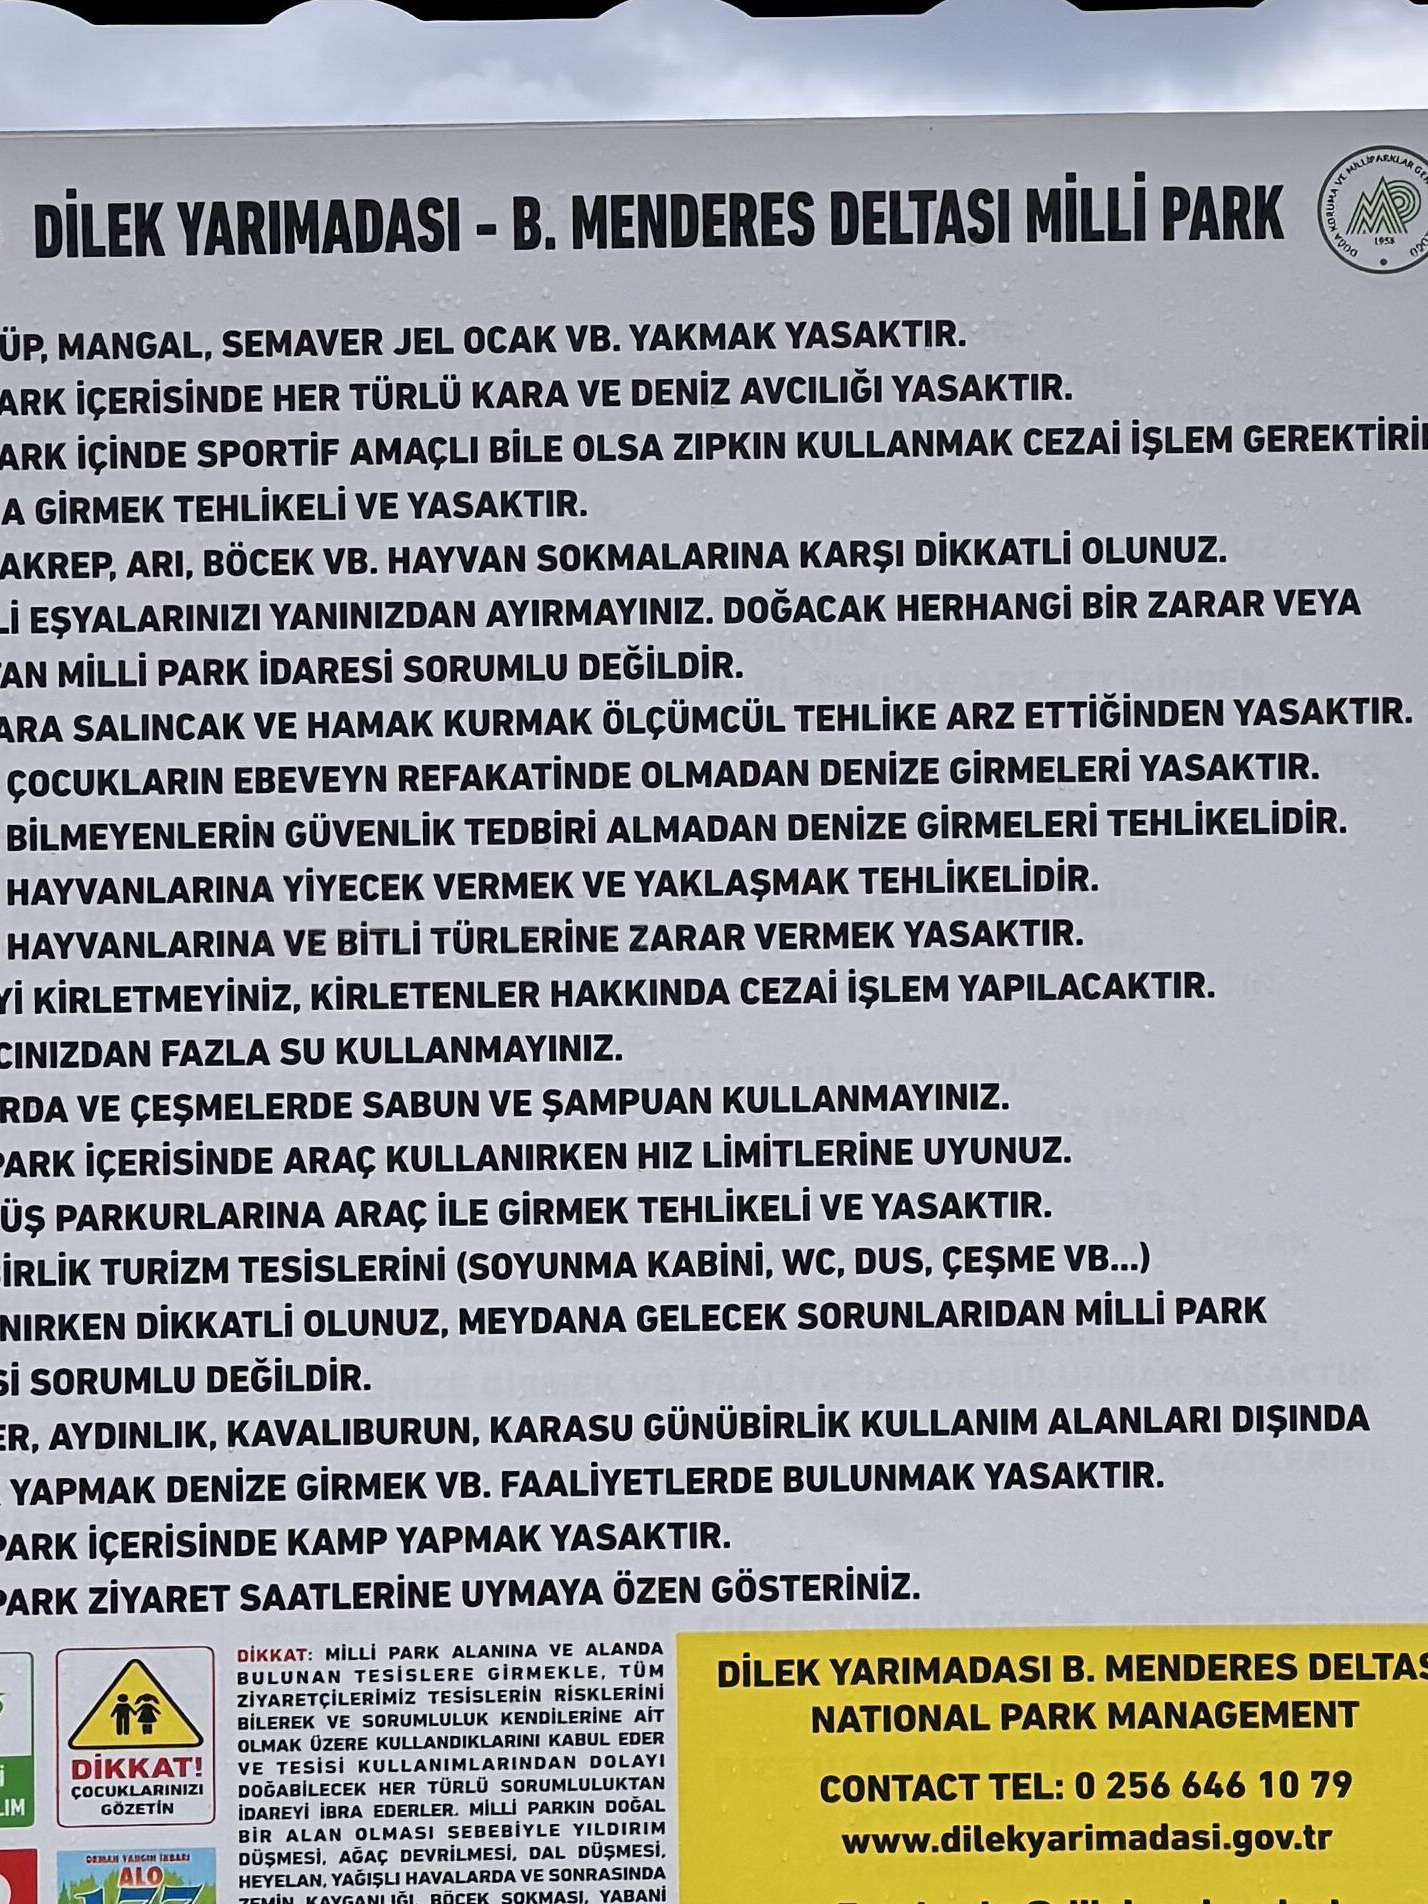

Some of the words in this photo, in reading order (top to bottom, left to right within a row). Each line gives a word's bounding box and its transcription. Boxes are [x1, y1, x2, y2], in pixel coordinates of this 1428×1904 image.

[35, 188, 166, 258] DİLEK
[176, 197, 460, 256] YARIMADASI
[513, 196, 556, 251] B.
[572, 191, 815, 250] MENDERES
[831, 188, 1010, 246] DELTASI
[1026, 171, 1146, 243] MİLLİ
[1163, 184, 1285, 241] PARK
[58, 331, 212, 361] MANGAL,
[222, 328, 383, 358] SEMAVER
[393, 327, 454, 355] JEL
[464, 325, 557, 354] OCAK
[565, 324, 621, 353] VB.
[629, 321, 776, 352] YAKMAK
[784, 320, 966, 349] YASAKTIR.
[78, 434, 187, 476] İÇİNDE
[197, 431, 339, 468] SPORTİF
[350, 436, 478, 471] AMAÇLI
[490, 427, 563, 464] BİLE
[573, 433, 664, 462] OLSA
[674, 431, 786, 461] ZIPKIN
[797, 428, 1013, 459] KULLANMAK
[1024, 420, 1121, 456] CEZAİ
[1131, 419, 1232, 461] İŞLEM
[35, 490, 164, 525] GİRMEK
[173, 485, 346, 523] TEHLİKELİ
[355, 492, 399, 520] VE
[407, 489, 588, 519] YASAKTIR.
[73, 713, 245, 742] SALINCAK
[253, 712, 297, 740] VE
[308, 710, 433, 739] HAMAK
[445, 708, 593, 737] KURMAK
[603, 697, 785, 740] ÖLÇÜMCÜL
[794, 696, 936, 732] TEHLİKE
[946, 702, 1015, 730] ARZ
[1026, 692, 1223, 729] ETTİĞİNDEN
[1233, 697, 1413, 726] YASAKTIR.
[161, 1038, 270, 1067] FAZLA
[280, 1037, 324, 1066] SU
[336, 1034, 623, 1065] KULLANMAYINIZ.
[30, 1366, 195, 1396] SORUMLU
[206, 1357, 371, 1393] DEĞİLDİR.
[88, 1579, 230, 1614] ZİYARET
[240, 1574, 452, 1612] SAATLERİNE
[462, 1578, 603, 1608] UYMAYA
[613, 1570, 700, 1605] ÖZEN
[711, 1565, 920, 1604] GÖSTERİNİZ.
[238, 1648, 313, 1663] DİKKAT:
[326, 1644, 376, 1661] MİLLİ
[389, 1645, 439, 1659] PARK
[452, 1644, 537, 1658] ALANINA
[549, 1643, 573, 1657] VE
[585, 1642, 663, 1656] ALANDA
[718, 1652, 820, 1688] DİLEK
[829, 1655, 1051, 1686] YARIMADASI
[1063, 1655, 1094, 1683] B.
[1106, 1653, 1298, 1682] MENDERES
[811, 1704, 991, 1733] NATIONAL
[1001, 1702, 1096, 1730] PARK
[1108, 1700, 1360, 1729] MANAGEMENT
[238, 1738, 301, 1753] OLMAK
[310, 1735, 368, 1752] ÜZERE
[377, 1734, 540, 1751] KULLANDIKLARINI
[549, 1732, 610, 1747] KABUL
[619, 1731, 664, 1746] EDER
[71, 1753, 203, 1780] DİKKAT!
[71, 1783, 204, 1799] ÇOCUKLARINIZI
[820, 1773, 980, 1803] CONTACT
[988, 1773, 1063, 1800] TEL:
[1075, 1772, 1094, 1799] 0
[1107, 1771, 1170, 1799] 256
[1182, 1770, 1245, 1798] 646
[1260, 1770, 1299, 1798] 10
[1311, 1770, 1352, 1798] 79
[100, 1799, 174, 1816] GÖZETİN
[339, 1846, 388, 1866] AĞAÇ
[529, 1846, 566, 1859] DAL
[842, 1823, 1333, 1858] www.dilekyarimadasi.gov.tr
[119, 1866, 164, 1885] ALO
